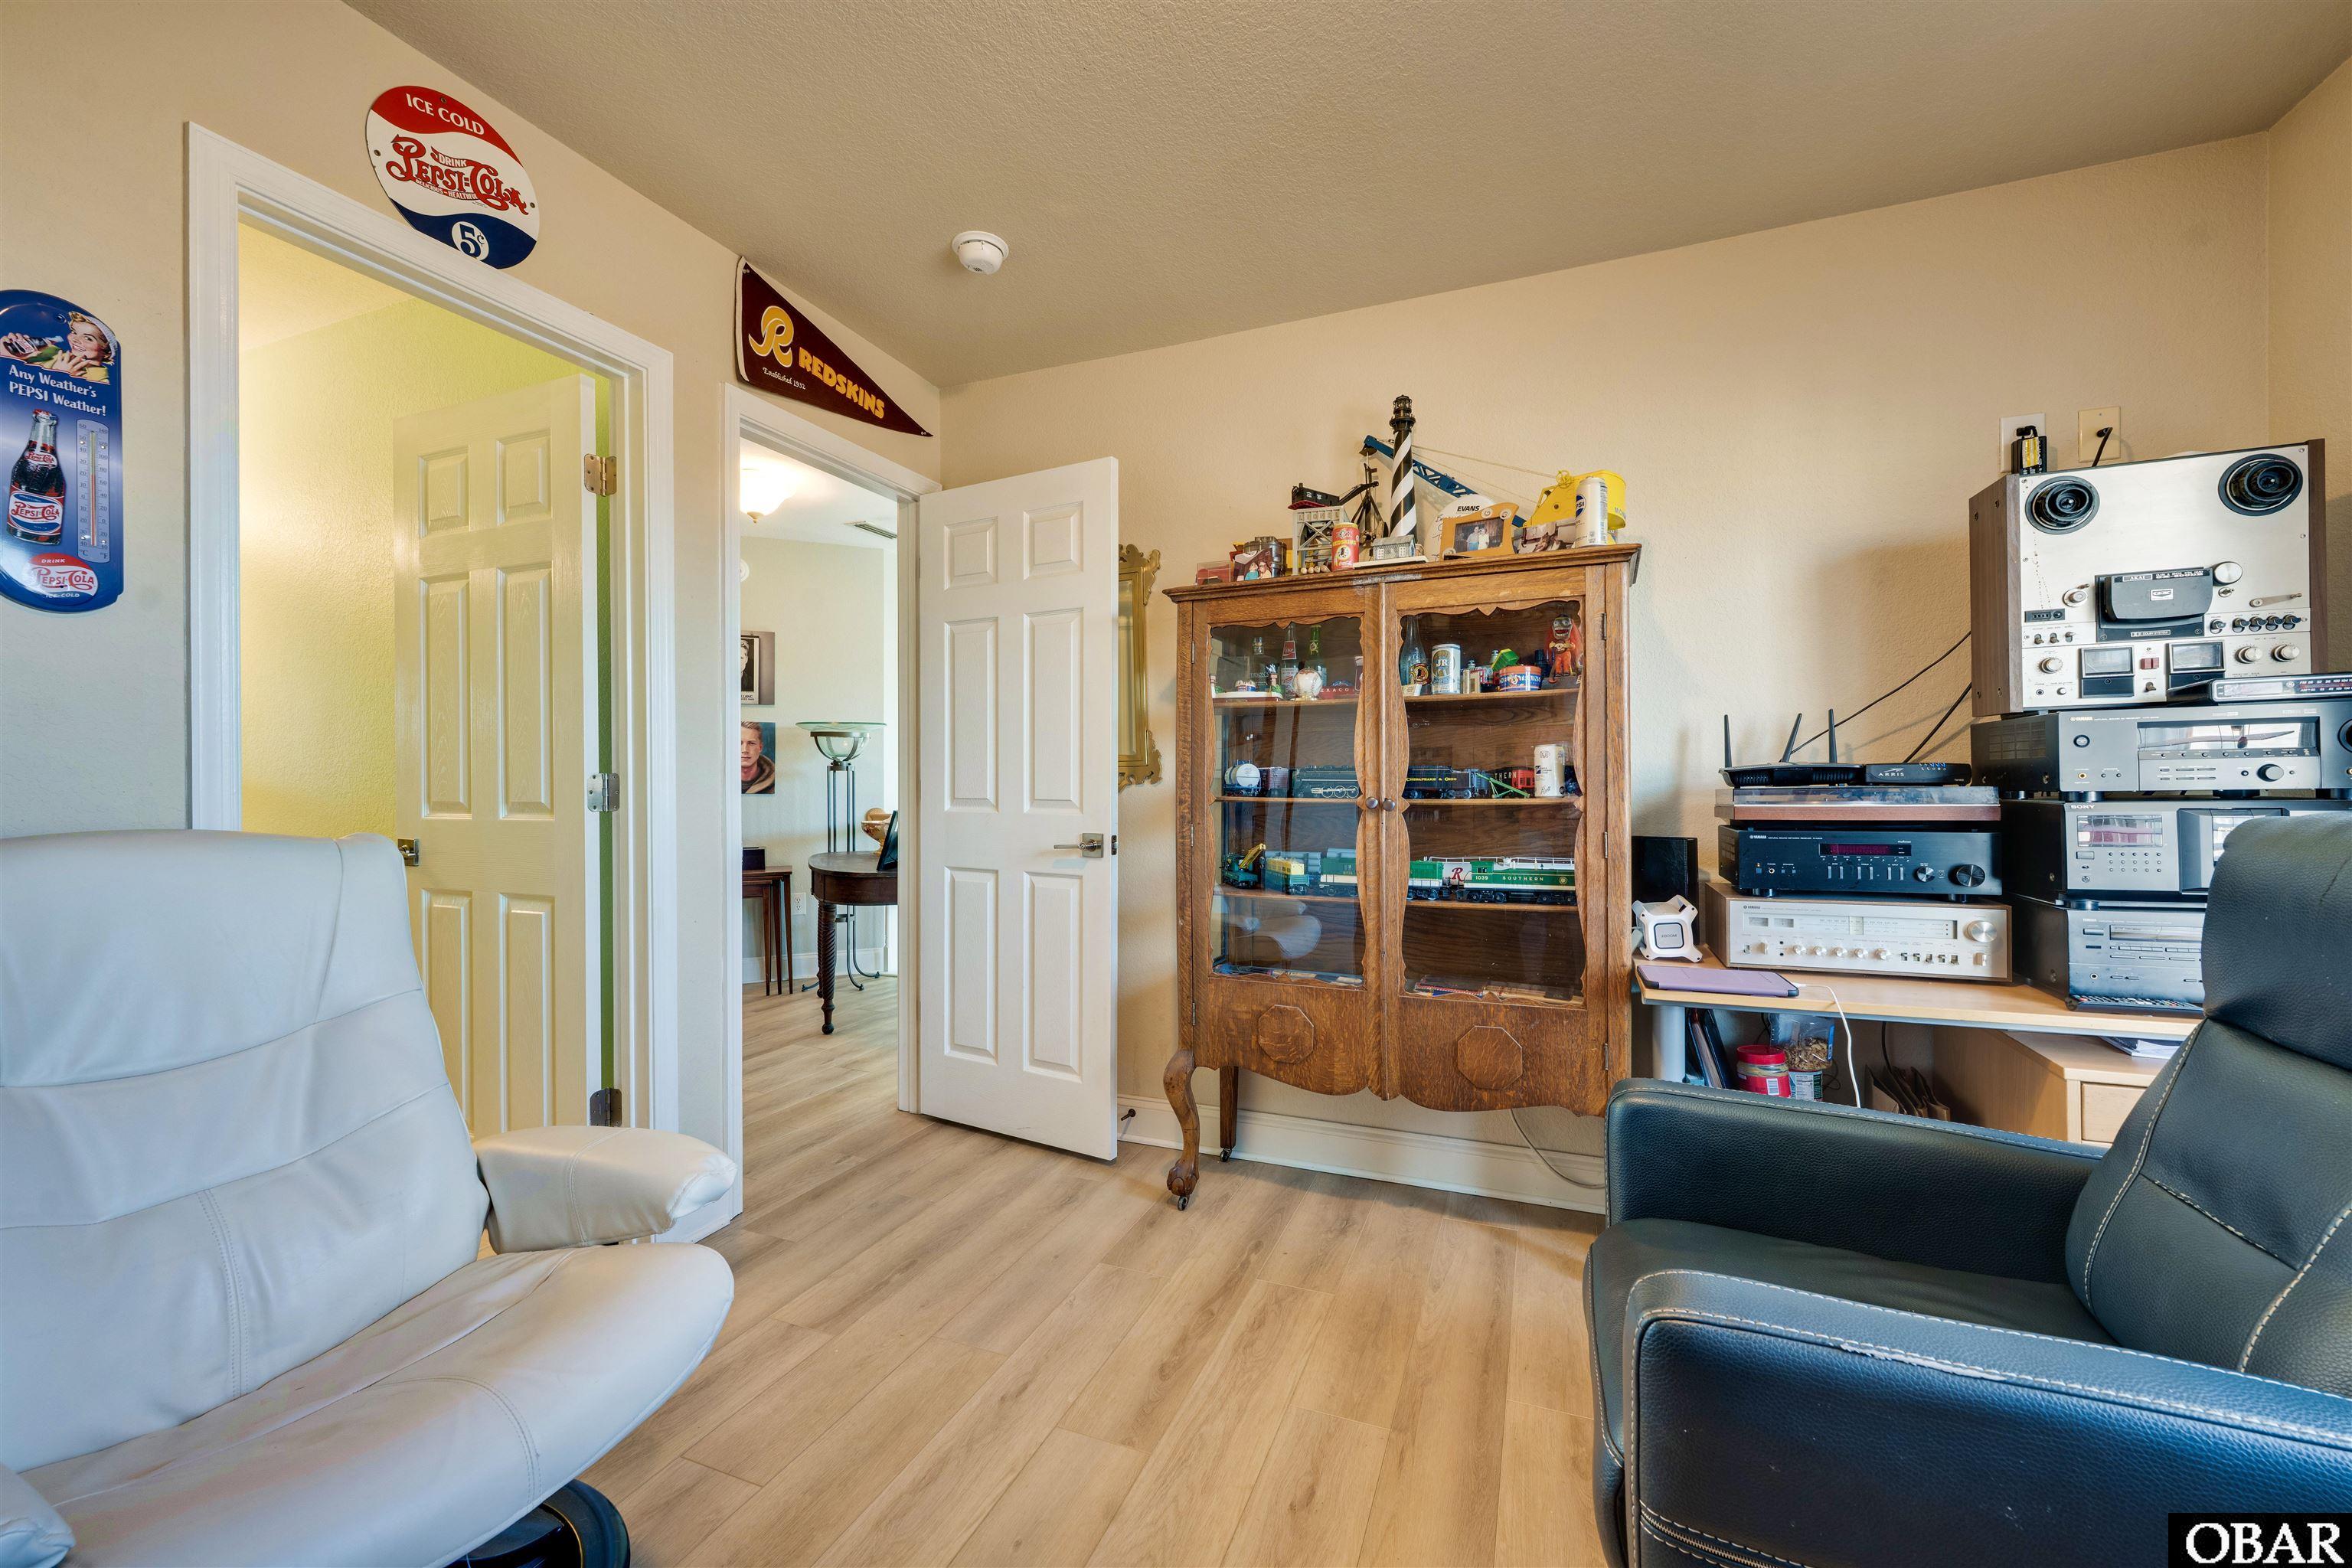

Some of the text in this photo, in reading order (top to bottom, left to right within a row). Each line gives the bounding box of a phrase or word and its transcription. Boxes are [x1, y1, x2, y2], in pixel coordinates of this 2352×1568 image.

[406, 93, 485, 136] ICE COLD
[439, 153, 468, 168] DRINK
[9, 364, 96, 397] Any Weather's
[763, 367, 806, 390] Established 1932
[799, 347, 885, 419] REDSKINS
[9, 381, 106, 416] PEPSI Weather!
[1494, 771, 1517, 779] THERN
